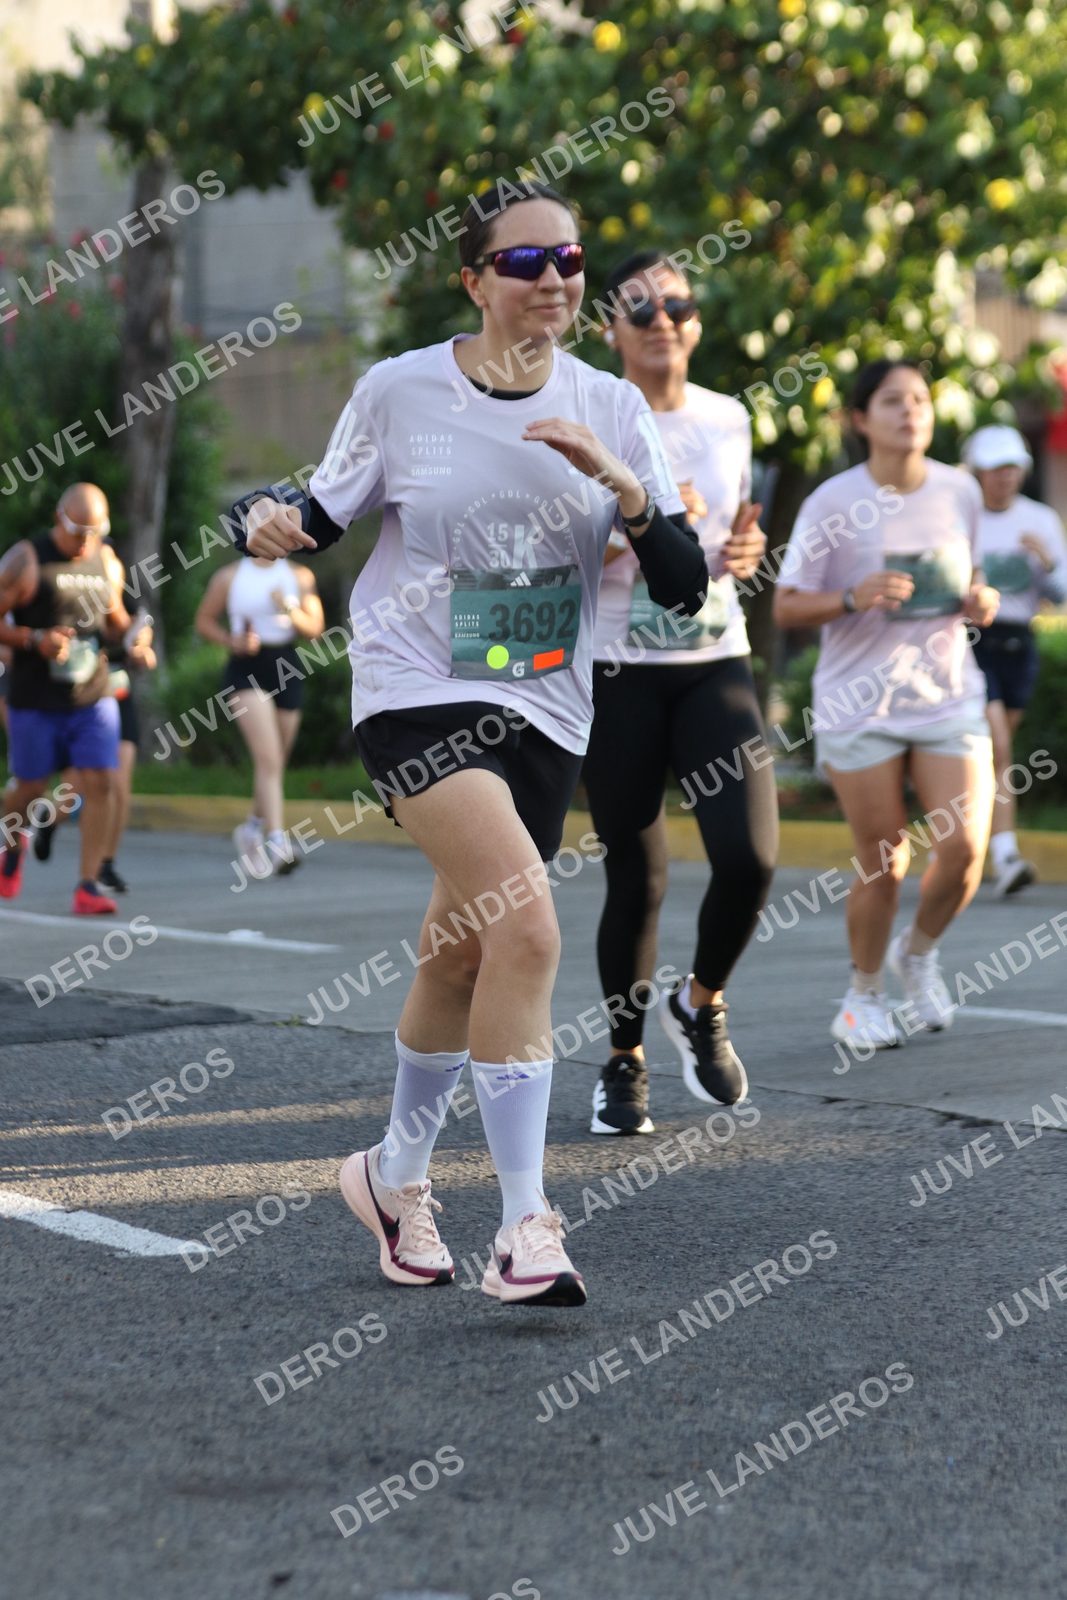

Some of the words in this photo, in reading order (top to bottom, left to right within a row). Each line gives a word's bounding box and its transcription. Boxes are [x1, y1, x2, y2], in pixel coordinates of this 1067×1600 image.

[409, 433, 453, 442] ADIDAS
[411, 446, 451, 456] SPLITS
[411, 466, 452, 476] SAMSUNG
[487, 522, 509, 542] 15
[488, 599, 577, 643] 3692
